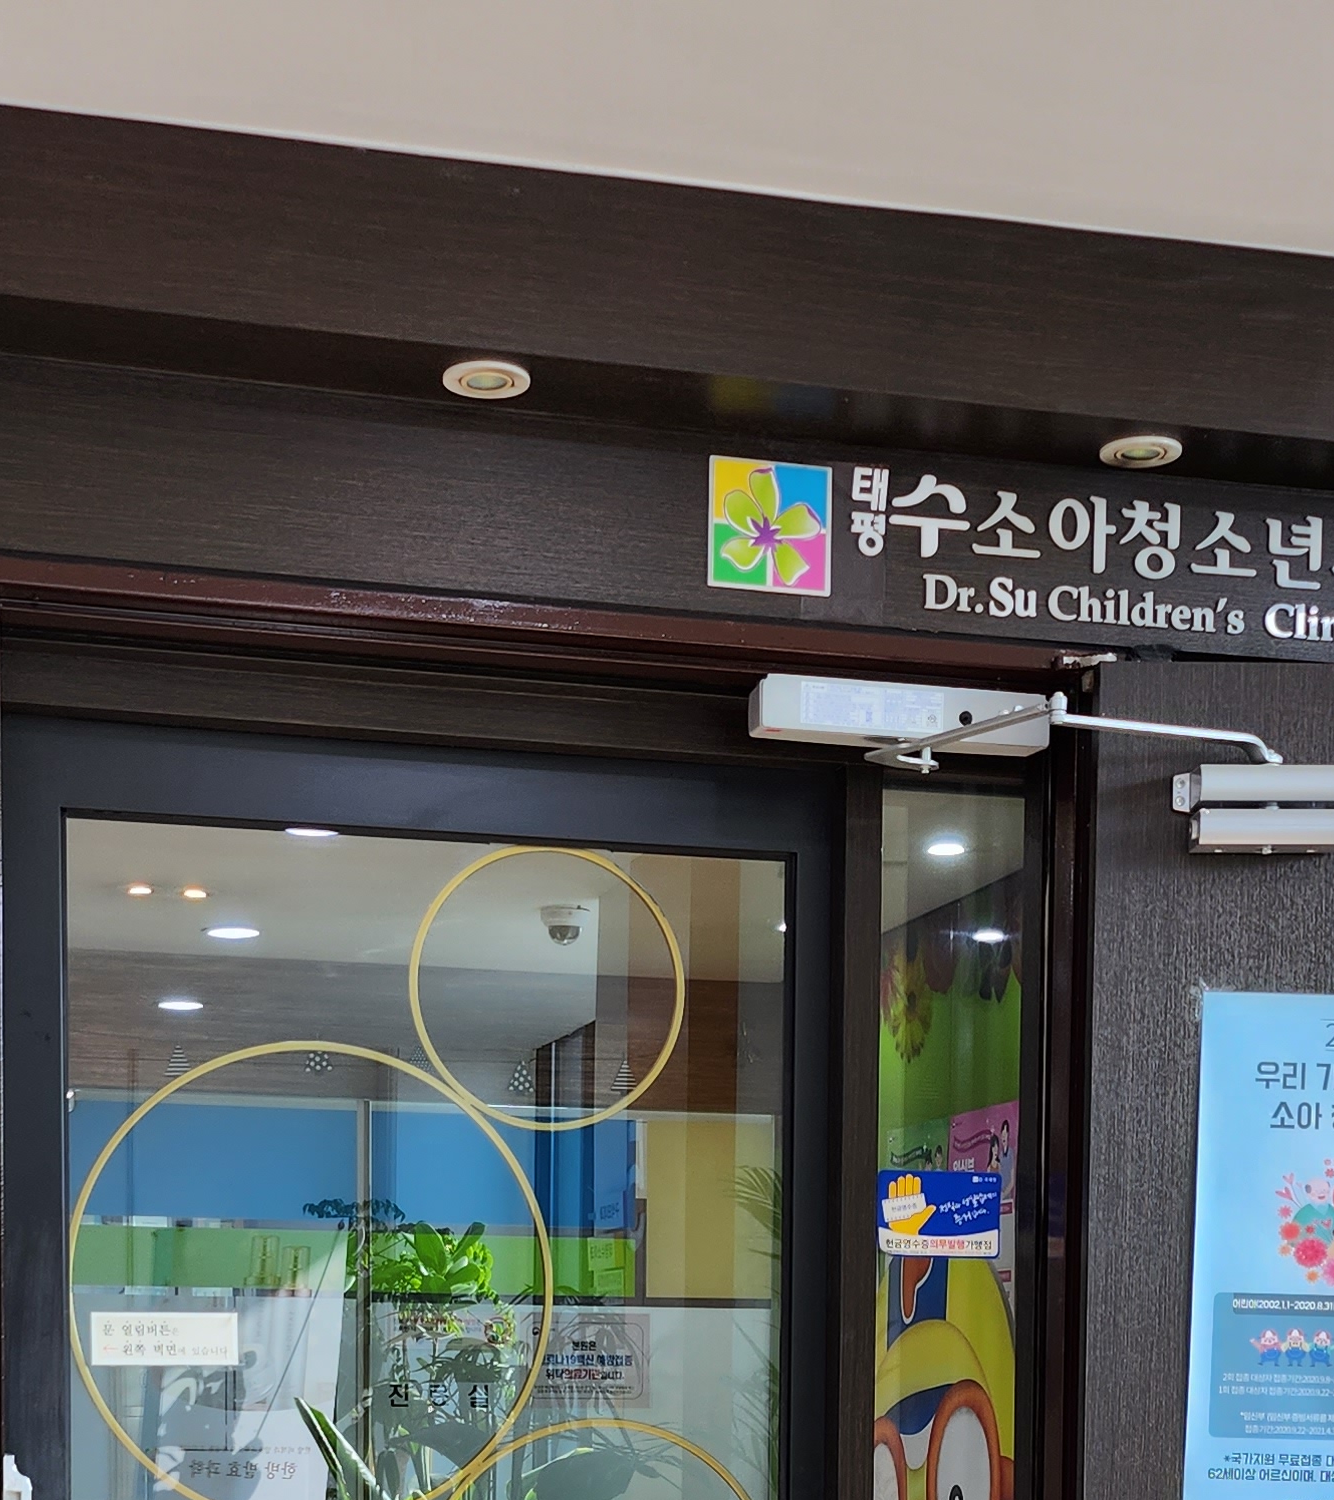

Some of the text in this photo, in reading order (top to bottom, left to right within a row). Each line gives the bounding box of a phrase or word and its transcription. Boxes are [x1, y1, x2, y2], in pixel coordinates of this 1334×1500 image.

[1048, 585, 1245, 634] Children's
[1255, 1061, 1307, 1090] 우리
[1270, 1102, 1322, 1130] 소아
[1278, 1454, 1322, 1467] 무료접종
